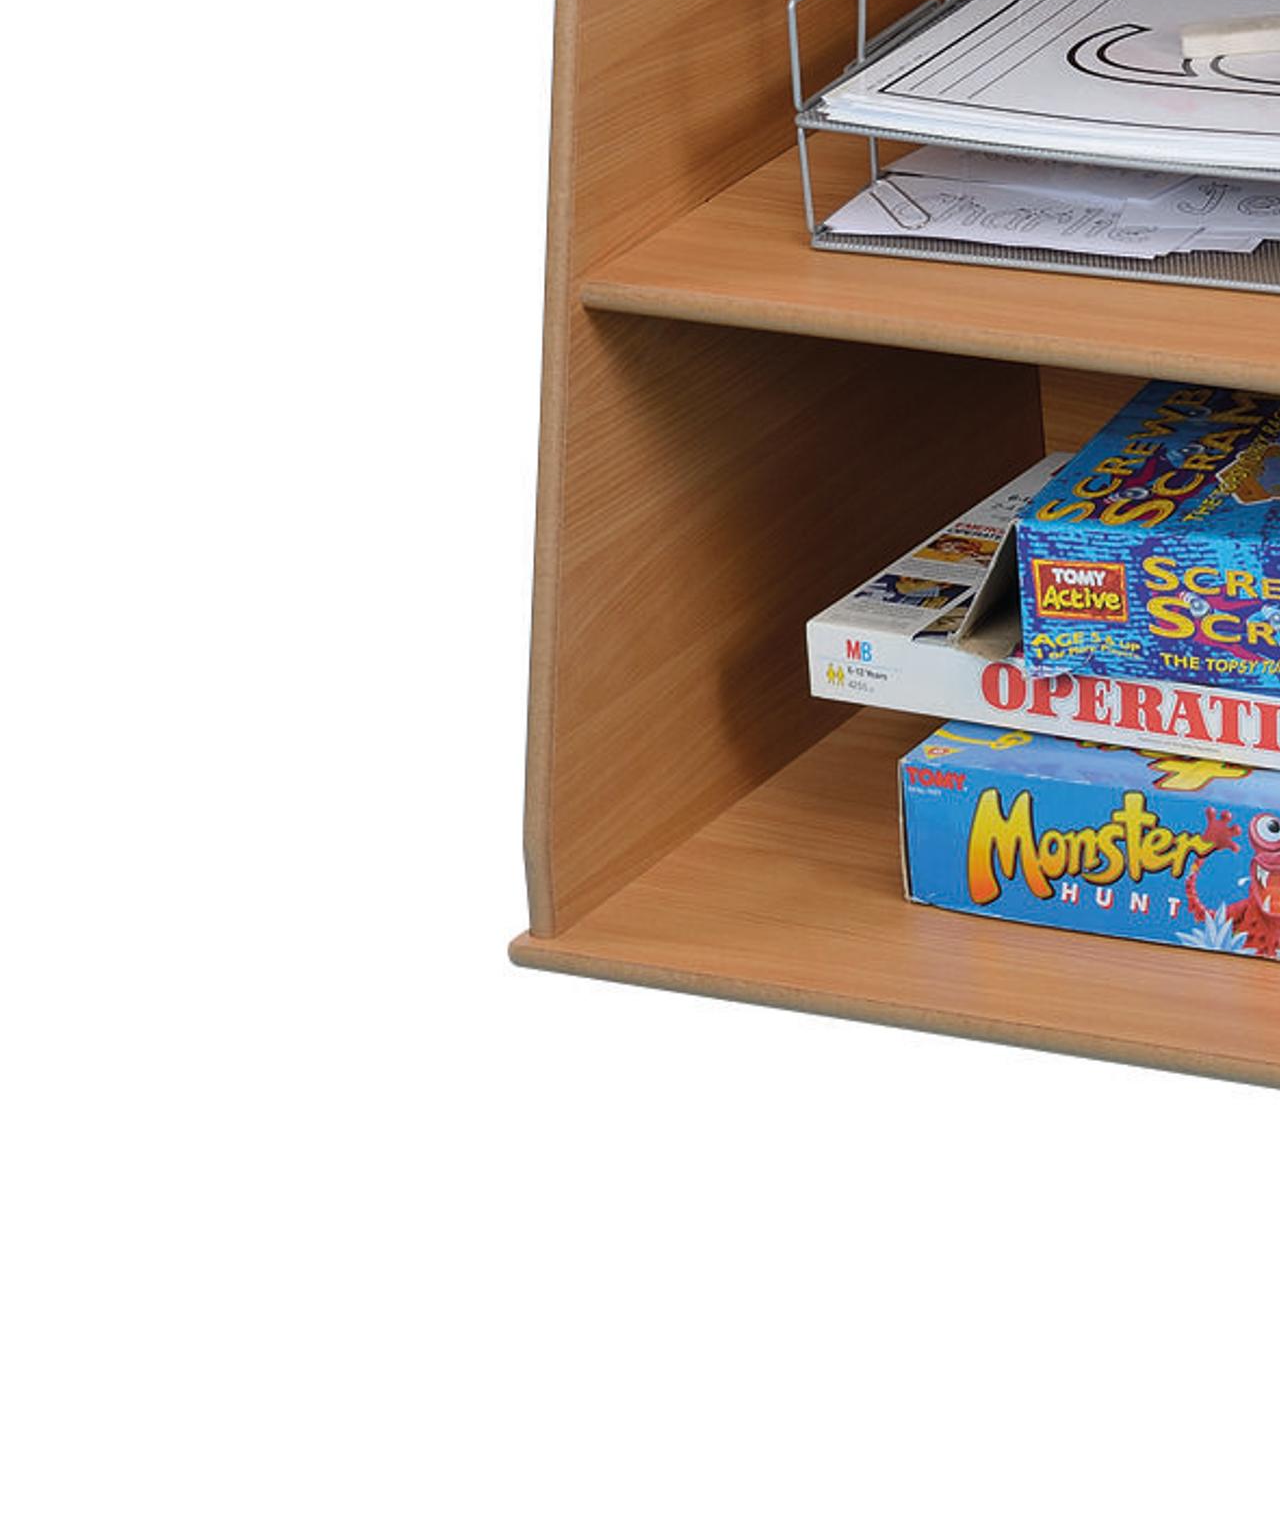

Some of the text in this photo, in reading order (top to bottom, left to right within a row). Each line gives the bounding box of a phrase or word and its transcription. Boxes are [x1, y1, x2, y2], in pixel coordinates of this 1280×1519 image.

[1050, 567, 1107, 587] TOMY
[1042, 585, 1122, 611] Active
[846, 639, 873, 662] MB
[1160, 651, 1199, 671] THE
[1205, 656, 1258, 674] TOPSY
[906, 765, 967, 791] TOMY
[967, 787, 1218, 906] Monster
[1061, 881, 1182, 918] HUNT
